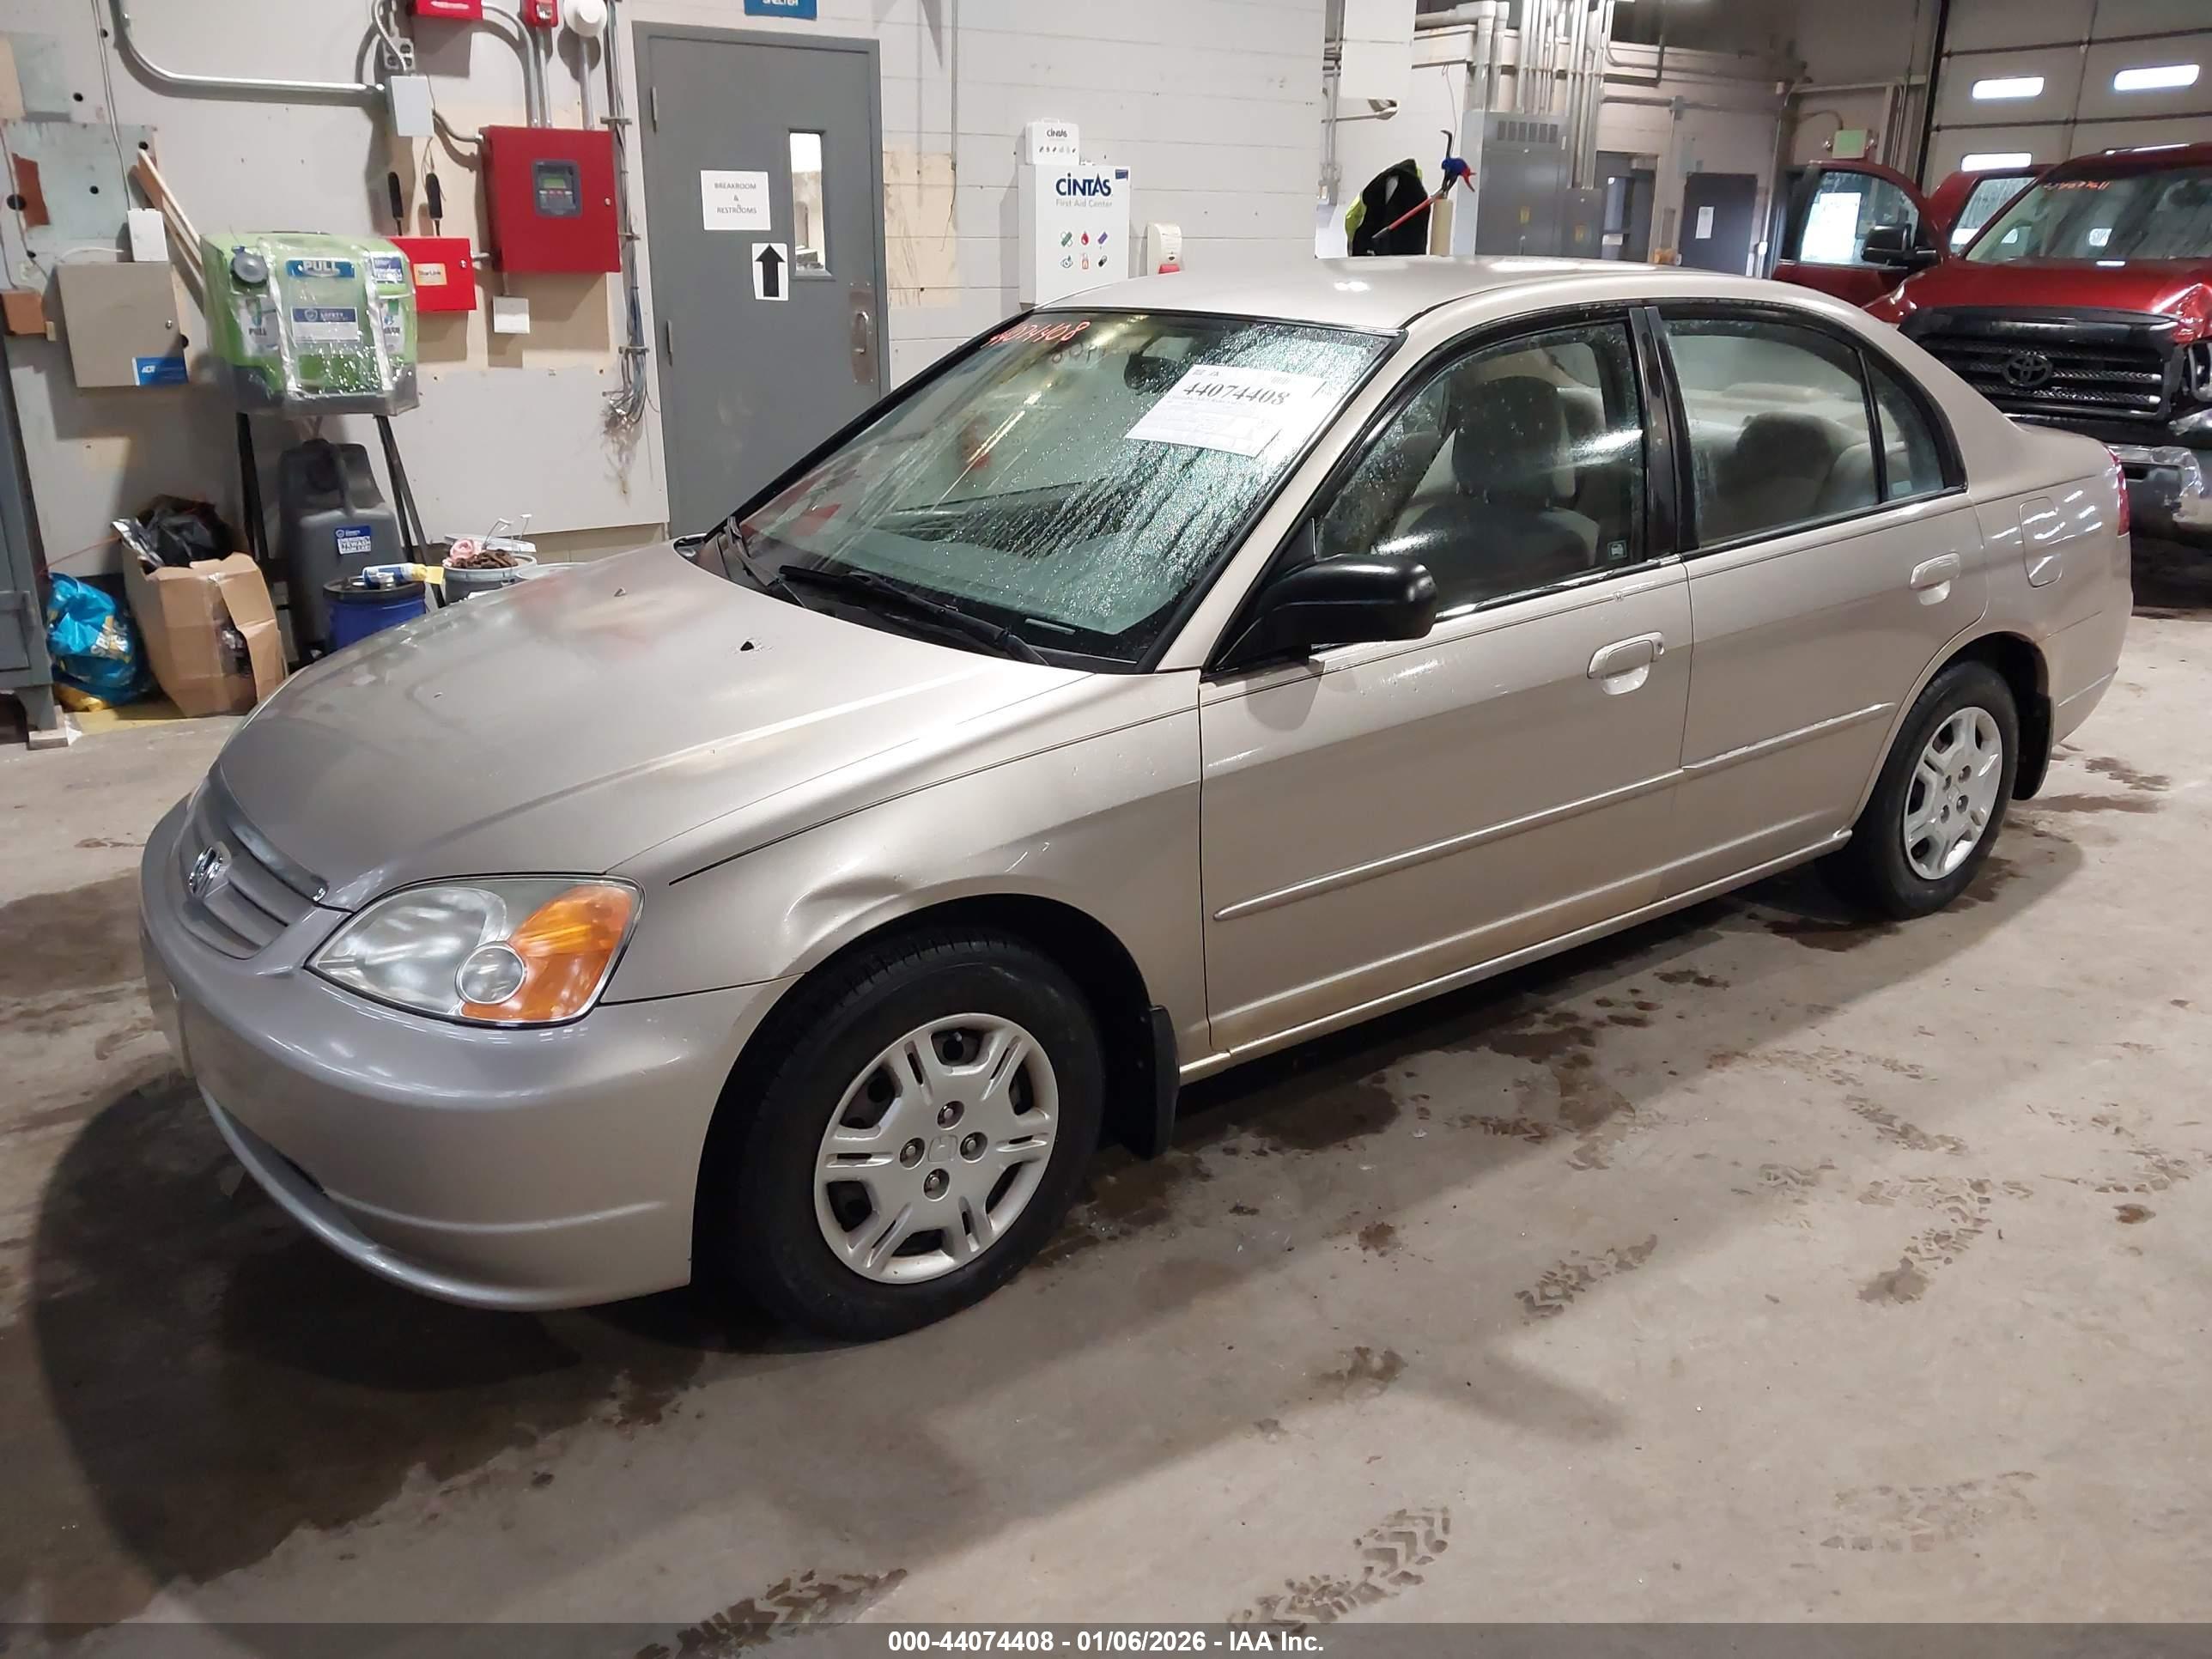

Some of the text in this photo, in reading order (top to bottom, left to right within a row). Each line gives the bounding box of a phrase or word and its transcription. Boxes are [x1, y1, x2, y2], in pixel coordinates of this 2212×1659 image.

[1055, 172, 1112, 197] CINTAS
[1055, 198, 1113, 208] First Aid Center
[302, 260, 337, 271] PULL
[1183, 381, 1291, 406] 44074408
